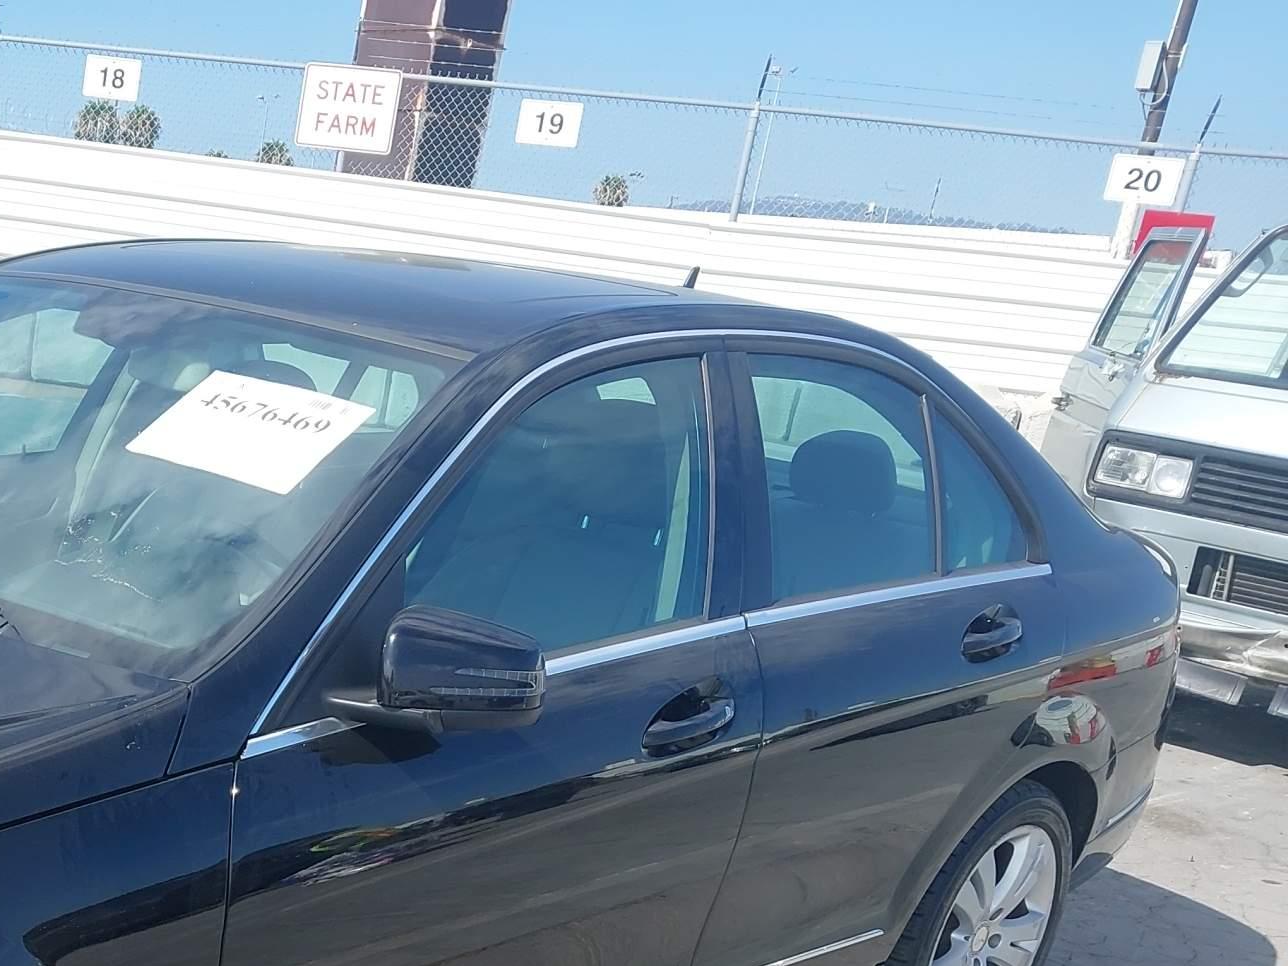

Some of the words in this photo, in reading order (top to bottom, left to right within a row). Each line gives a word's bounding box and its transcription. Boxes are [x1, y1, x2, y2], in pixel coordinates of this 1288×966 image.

[100, 67, 125, 89] 18
[316, 80, 385, 105] STATE
[314, 112, 377, 137] FARM
[536, 111, 564, 135] 19
[1123, 167, 1162, 192] 20
[200, 393, 331, 433] 45676469
